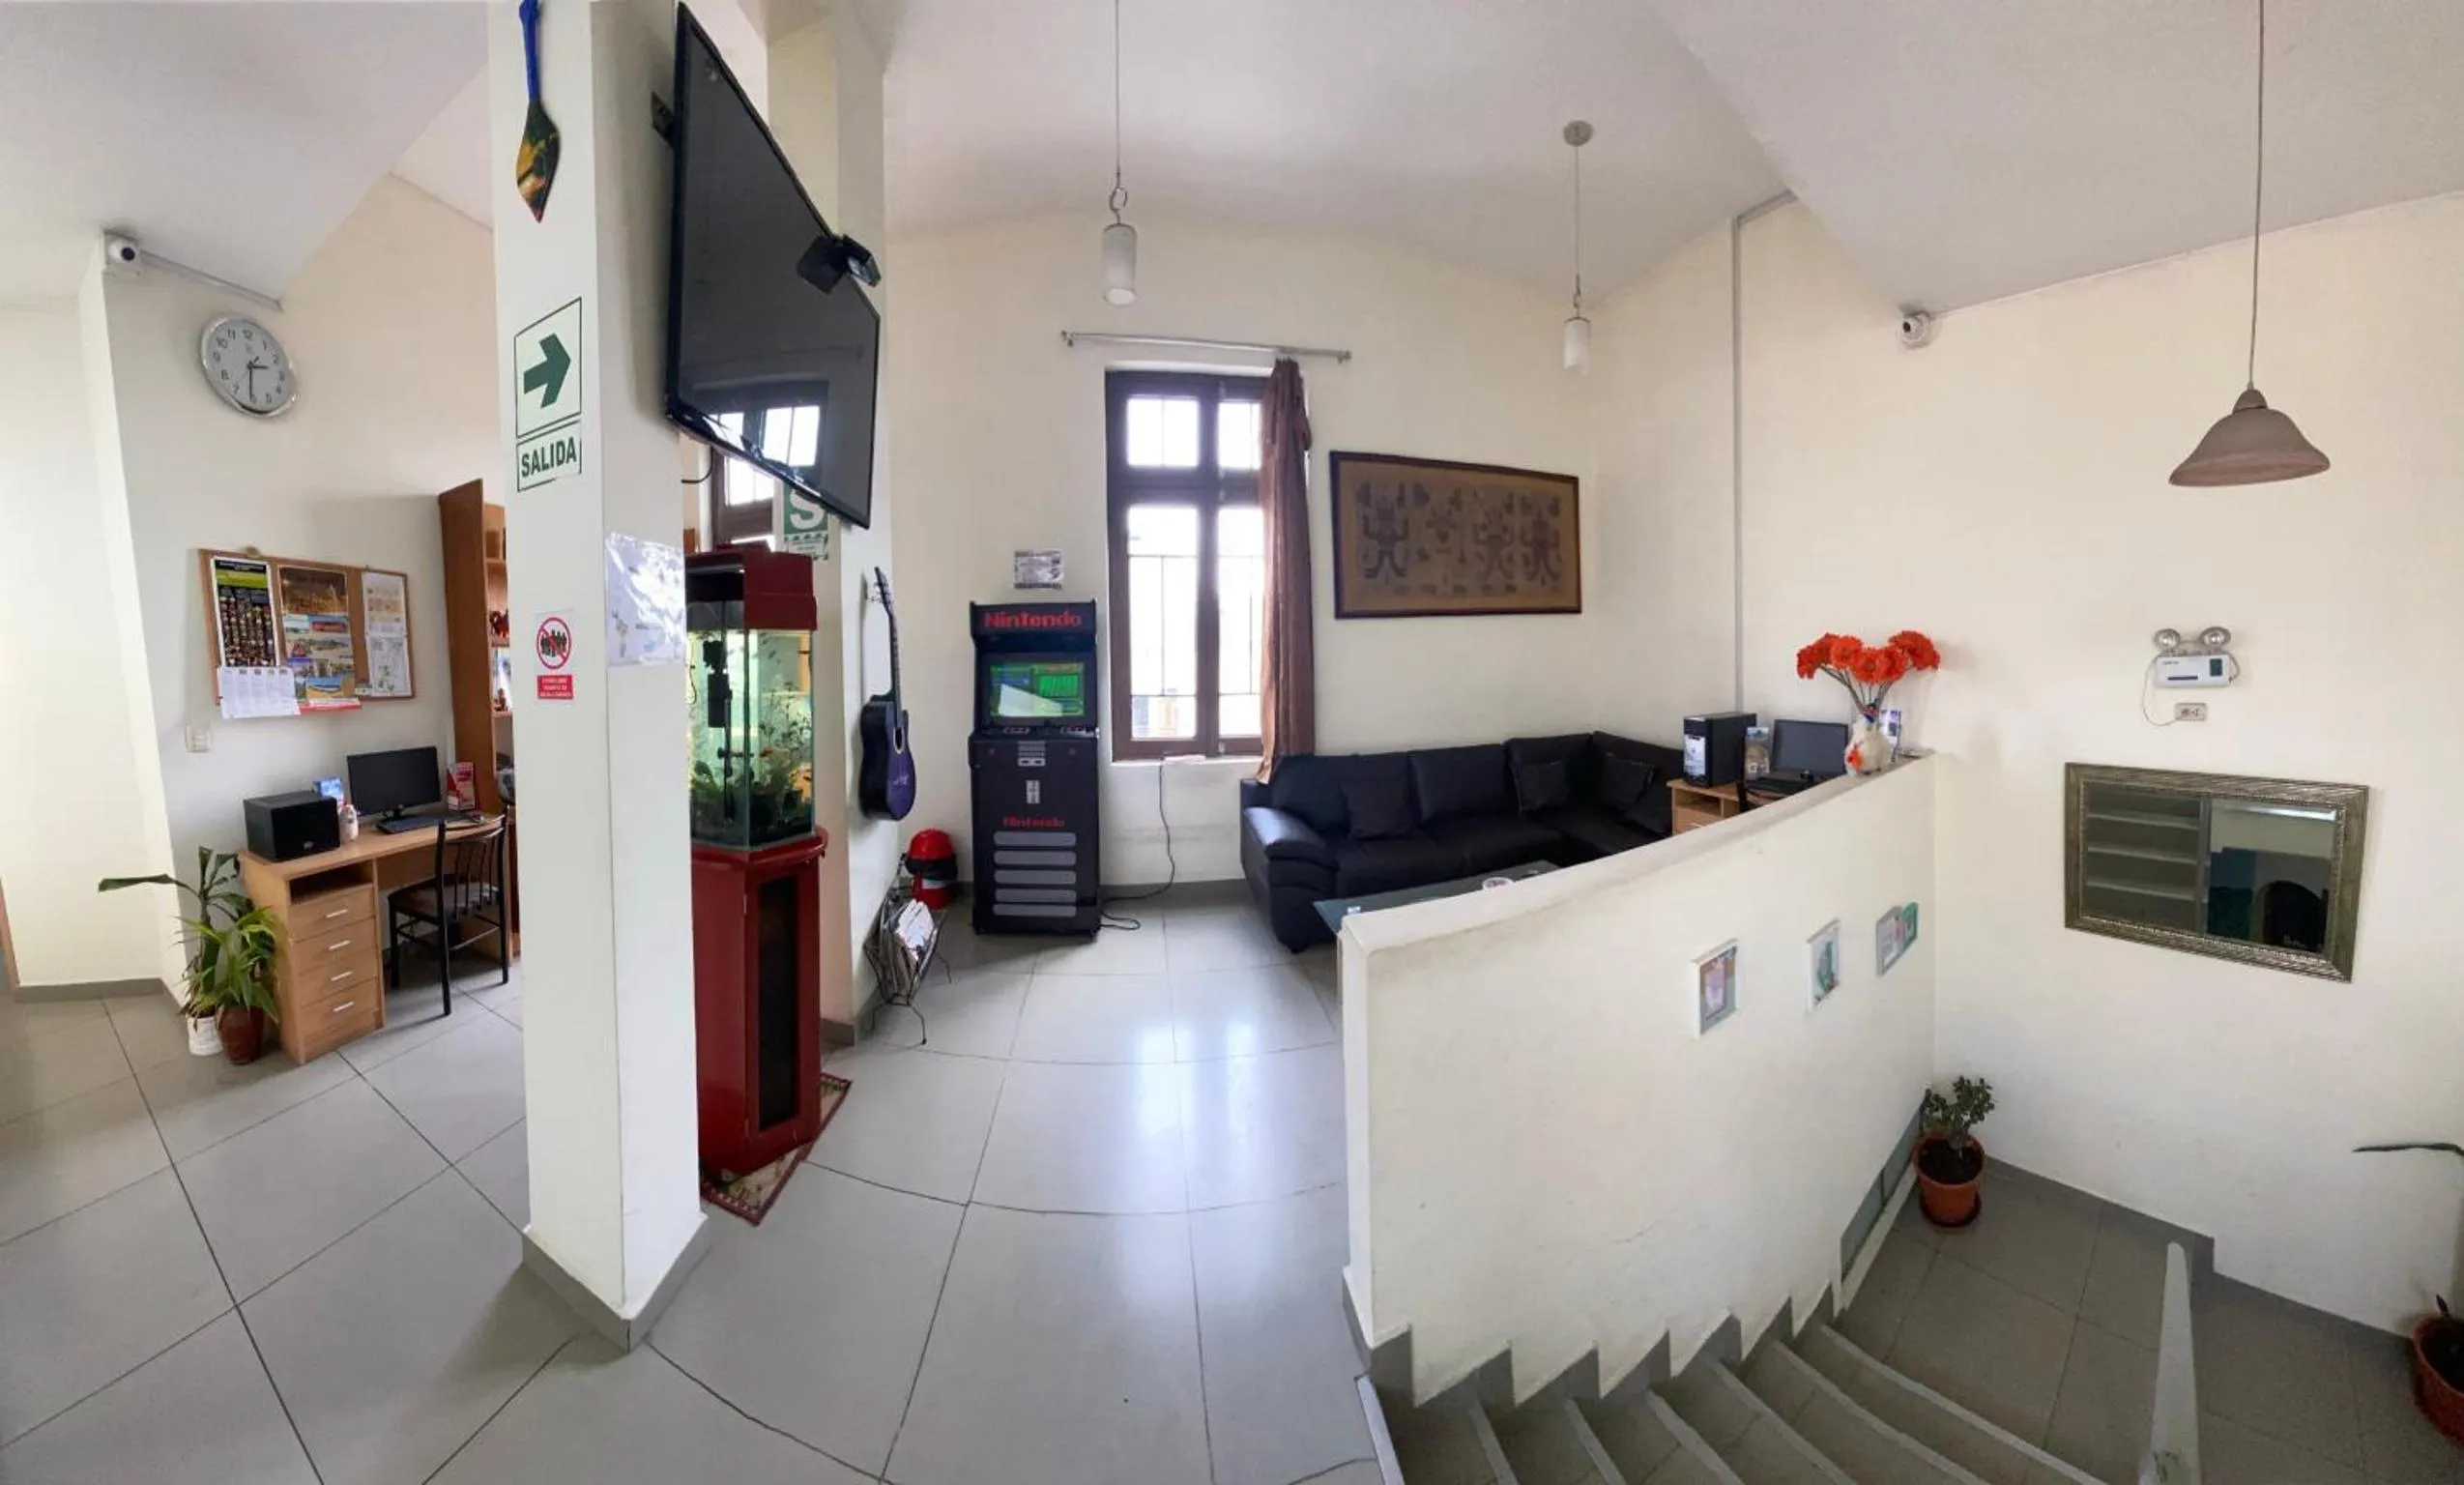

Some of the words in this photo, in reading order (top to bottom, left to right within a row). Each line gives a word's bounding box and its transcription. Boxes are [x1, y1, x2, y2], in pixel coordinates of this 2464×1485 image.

[521, 436, 577, 478] SALIDA
[790, 488, 825, 530] S
[984, 609, 1082, 627] Nintendo
[1001, 816, 1065, 829] Nintendo
